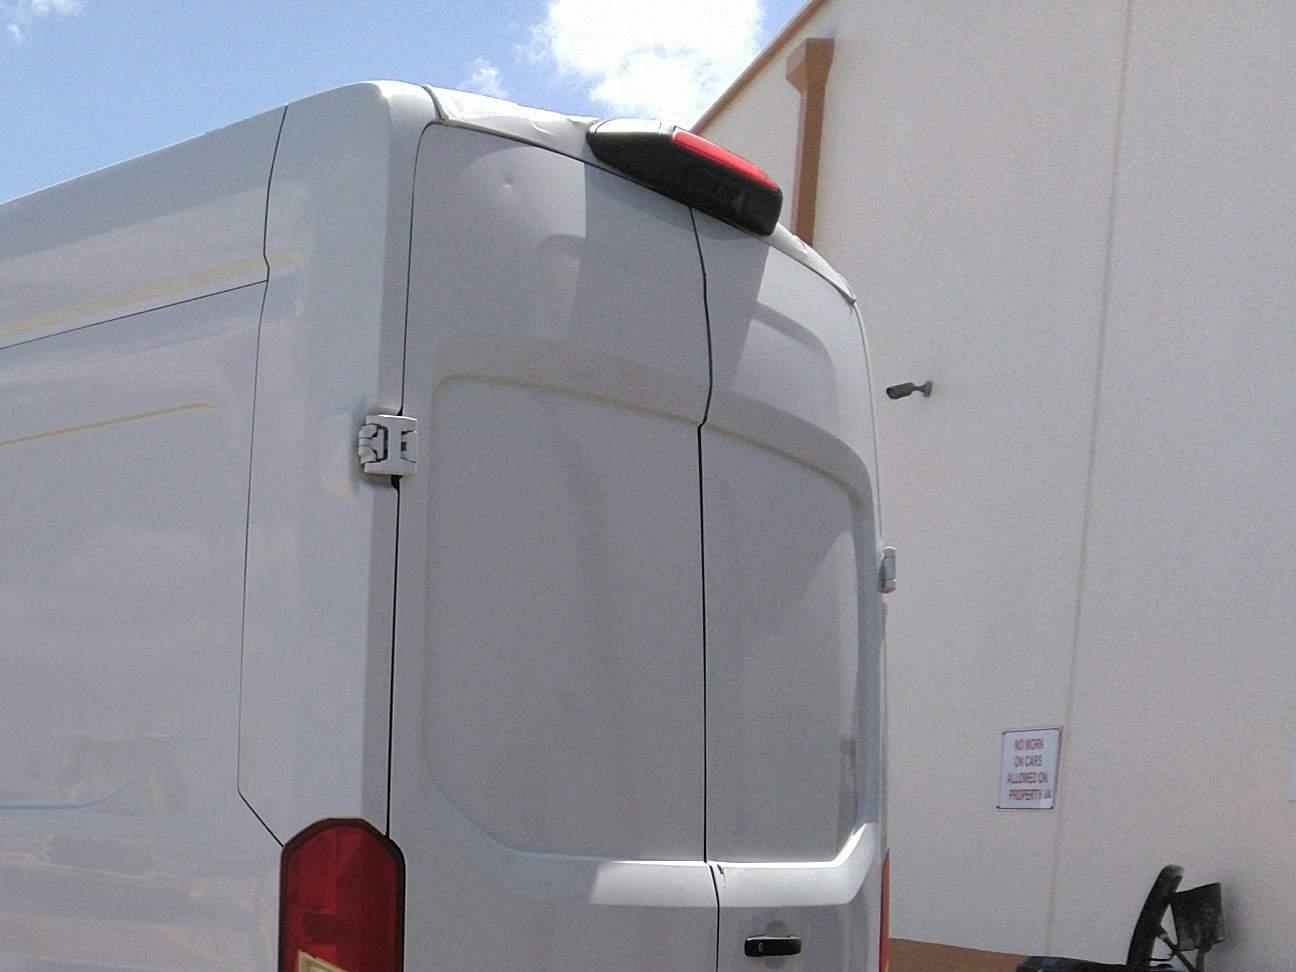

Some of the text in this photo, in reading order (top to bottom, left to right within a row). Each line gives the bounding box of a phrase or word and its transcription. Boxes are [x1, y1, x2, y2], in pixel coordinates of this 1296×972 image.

[1015, 738, 1044, 750] NO WORK
[1015, 754, 1043, 768] ON CARS
[1008, 772, 1048, 784] ALLOWED ON
[1009, 789, 1041, 801] PROPERTY
